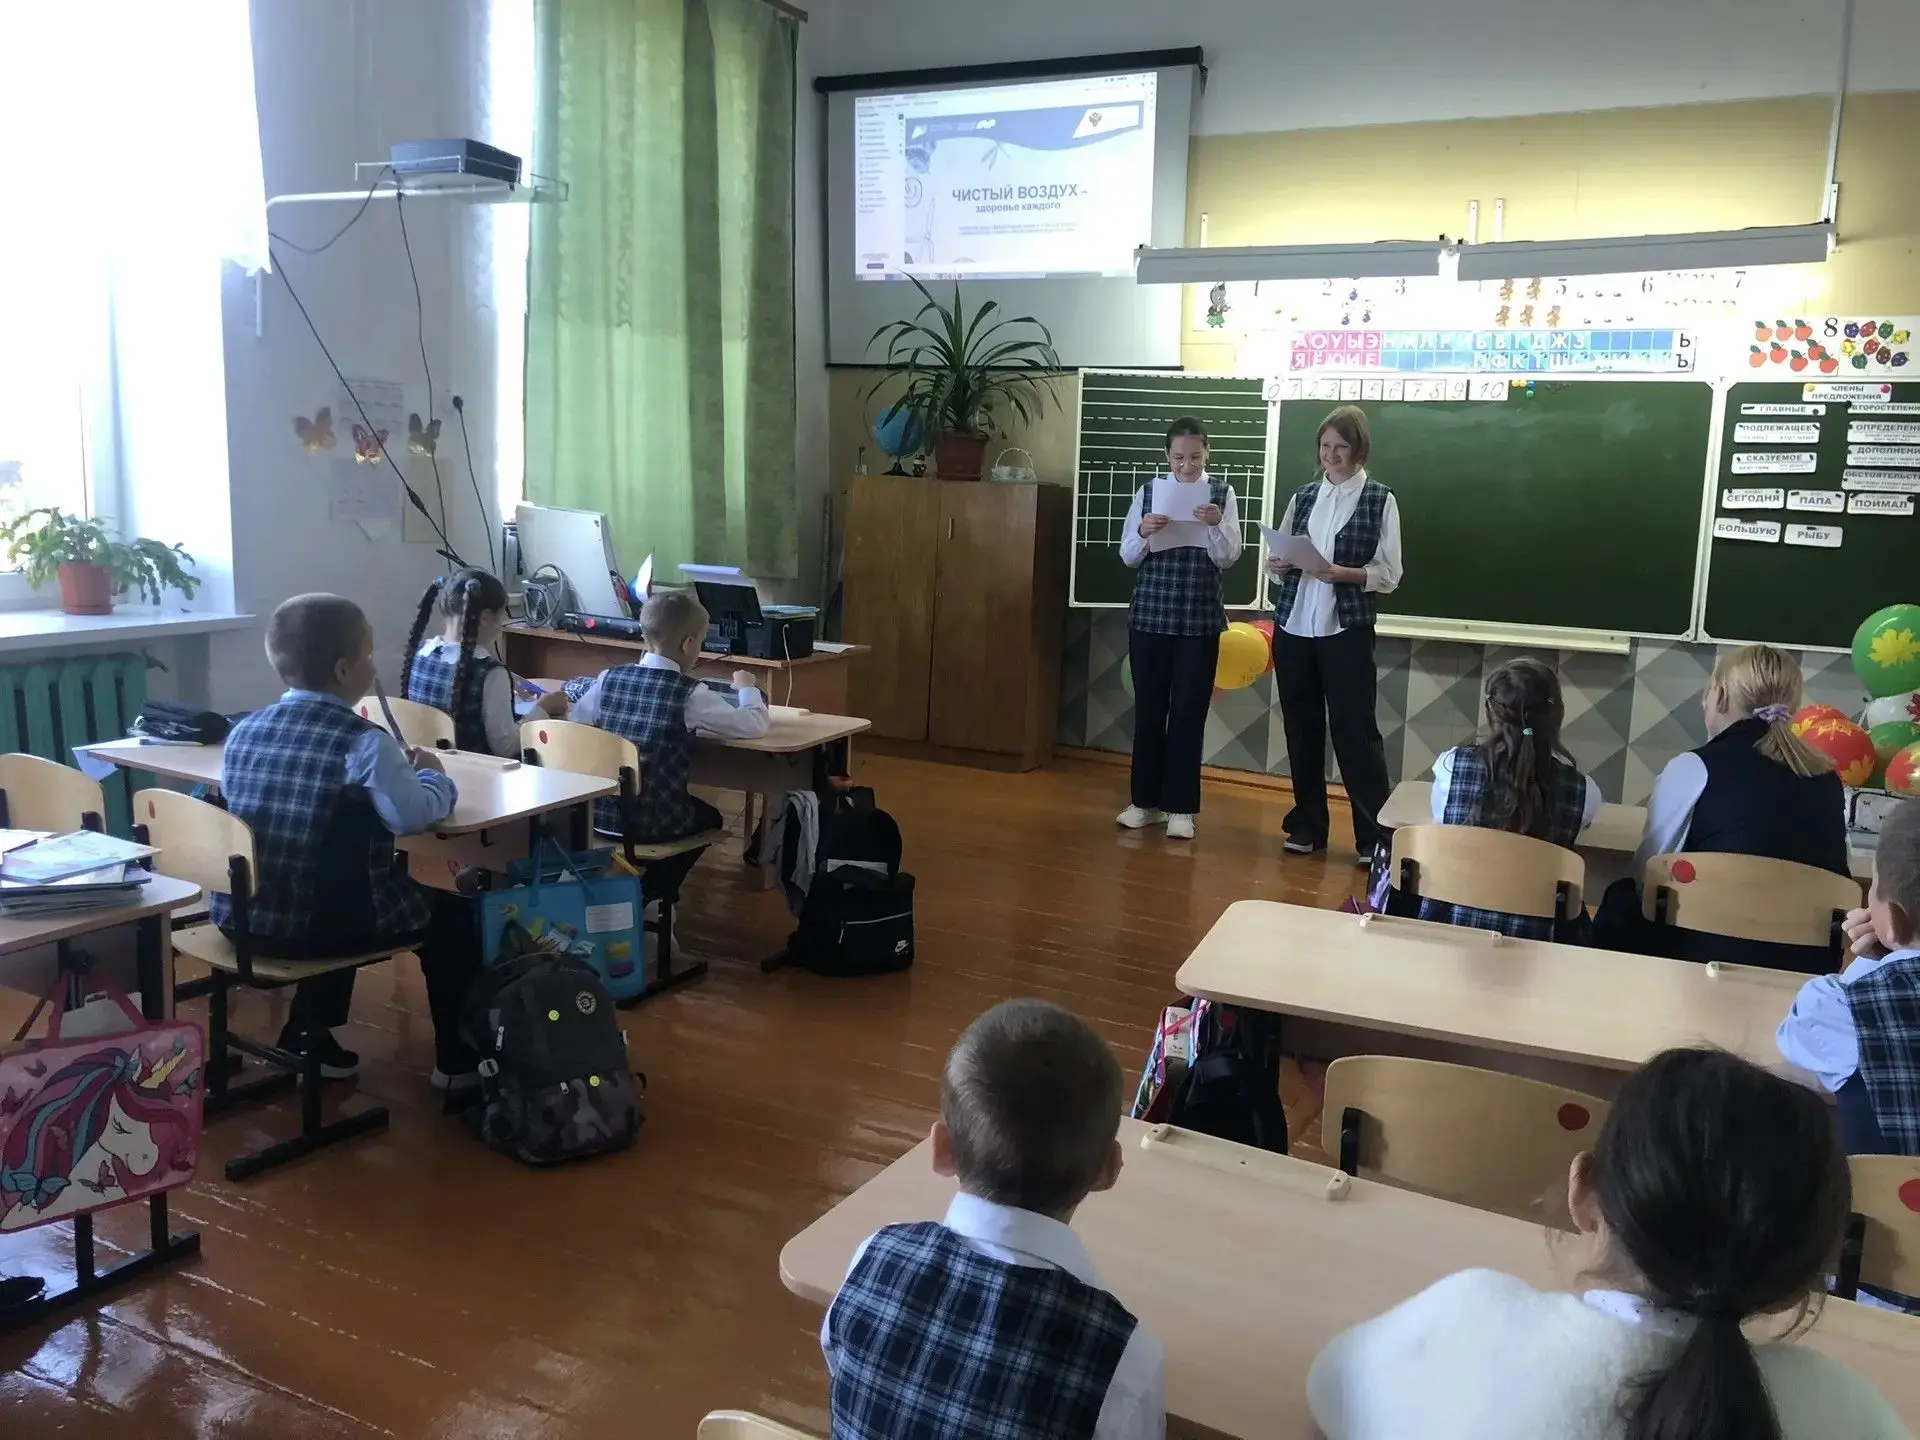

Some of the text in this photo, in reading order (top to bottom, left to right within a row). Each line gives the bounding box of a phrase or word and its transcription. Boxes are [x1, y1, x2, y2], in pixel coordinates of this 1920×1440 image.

[952, 184, 1013, 201] ЧИСТЫЙ
[1018, 183, 1078, 200] ВОЗДУХ
[975, 201, 1060, 213] здоровье каждого
[1823, 317, 1839, 338] 8
[1830, 385, 1865, 393] ЧЛЕНЫ
[1760, 405, 1807, 413] ГЛАВНЫЕ
[1742, 424, 1812, 432] ПОДЛЕЖАЩЕЕ
[1746, 453, 1803, 461] СКАЗУЕМОЕ
[1726, 494, 1780, 503] СЕГОДНЯ
[1799, 496, 1833, 506] ПАПА
[1717, 523, 1831, 541] БОЛЬШУЮ РЫБУ
